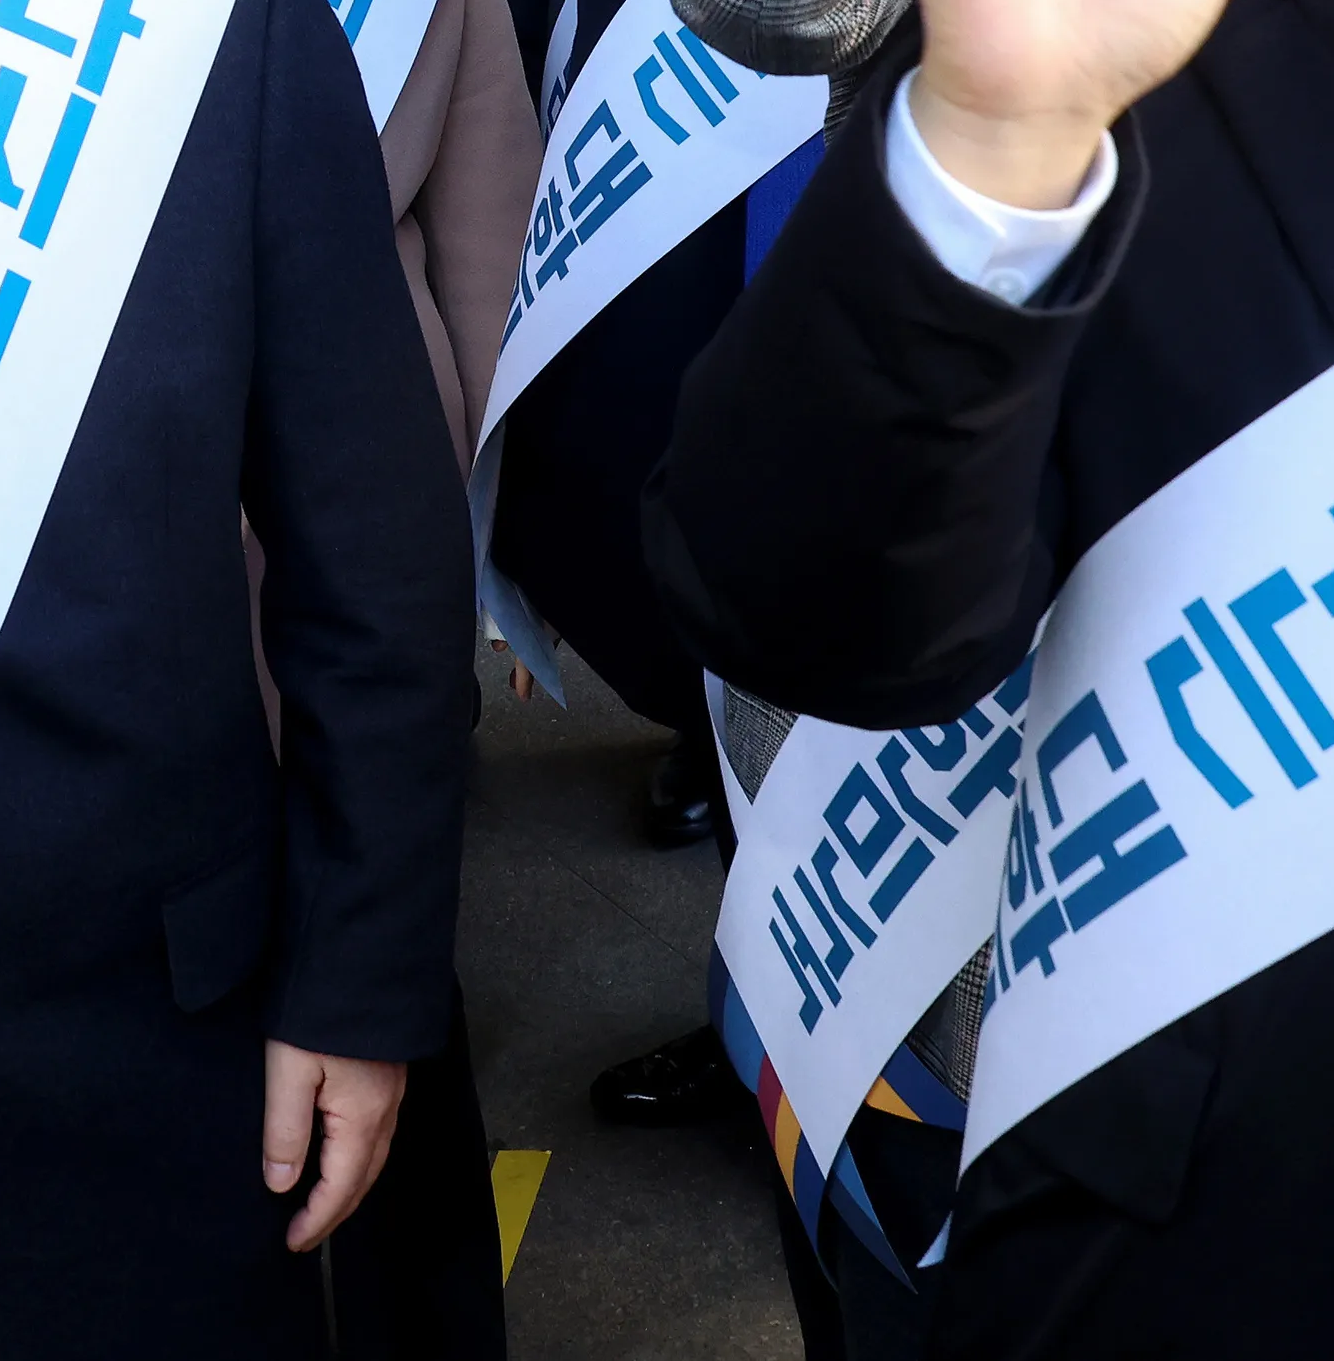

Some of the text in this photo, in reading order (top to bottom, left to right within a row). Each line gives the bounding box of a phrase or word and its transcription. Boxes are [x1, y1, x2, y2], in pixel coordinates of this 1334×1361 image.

[499, 26, 768, 361] 는 대한
[768, 651, 1036, 1037] 한민국
[982, 688, 1189, 1018] 대한
